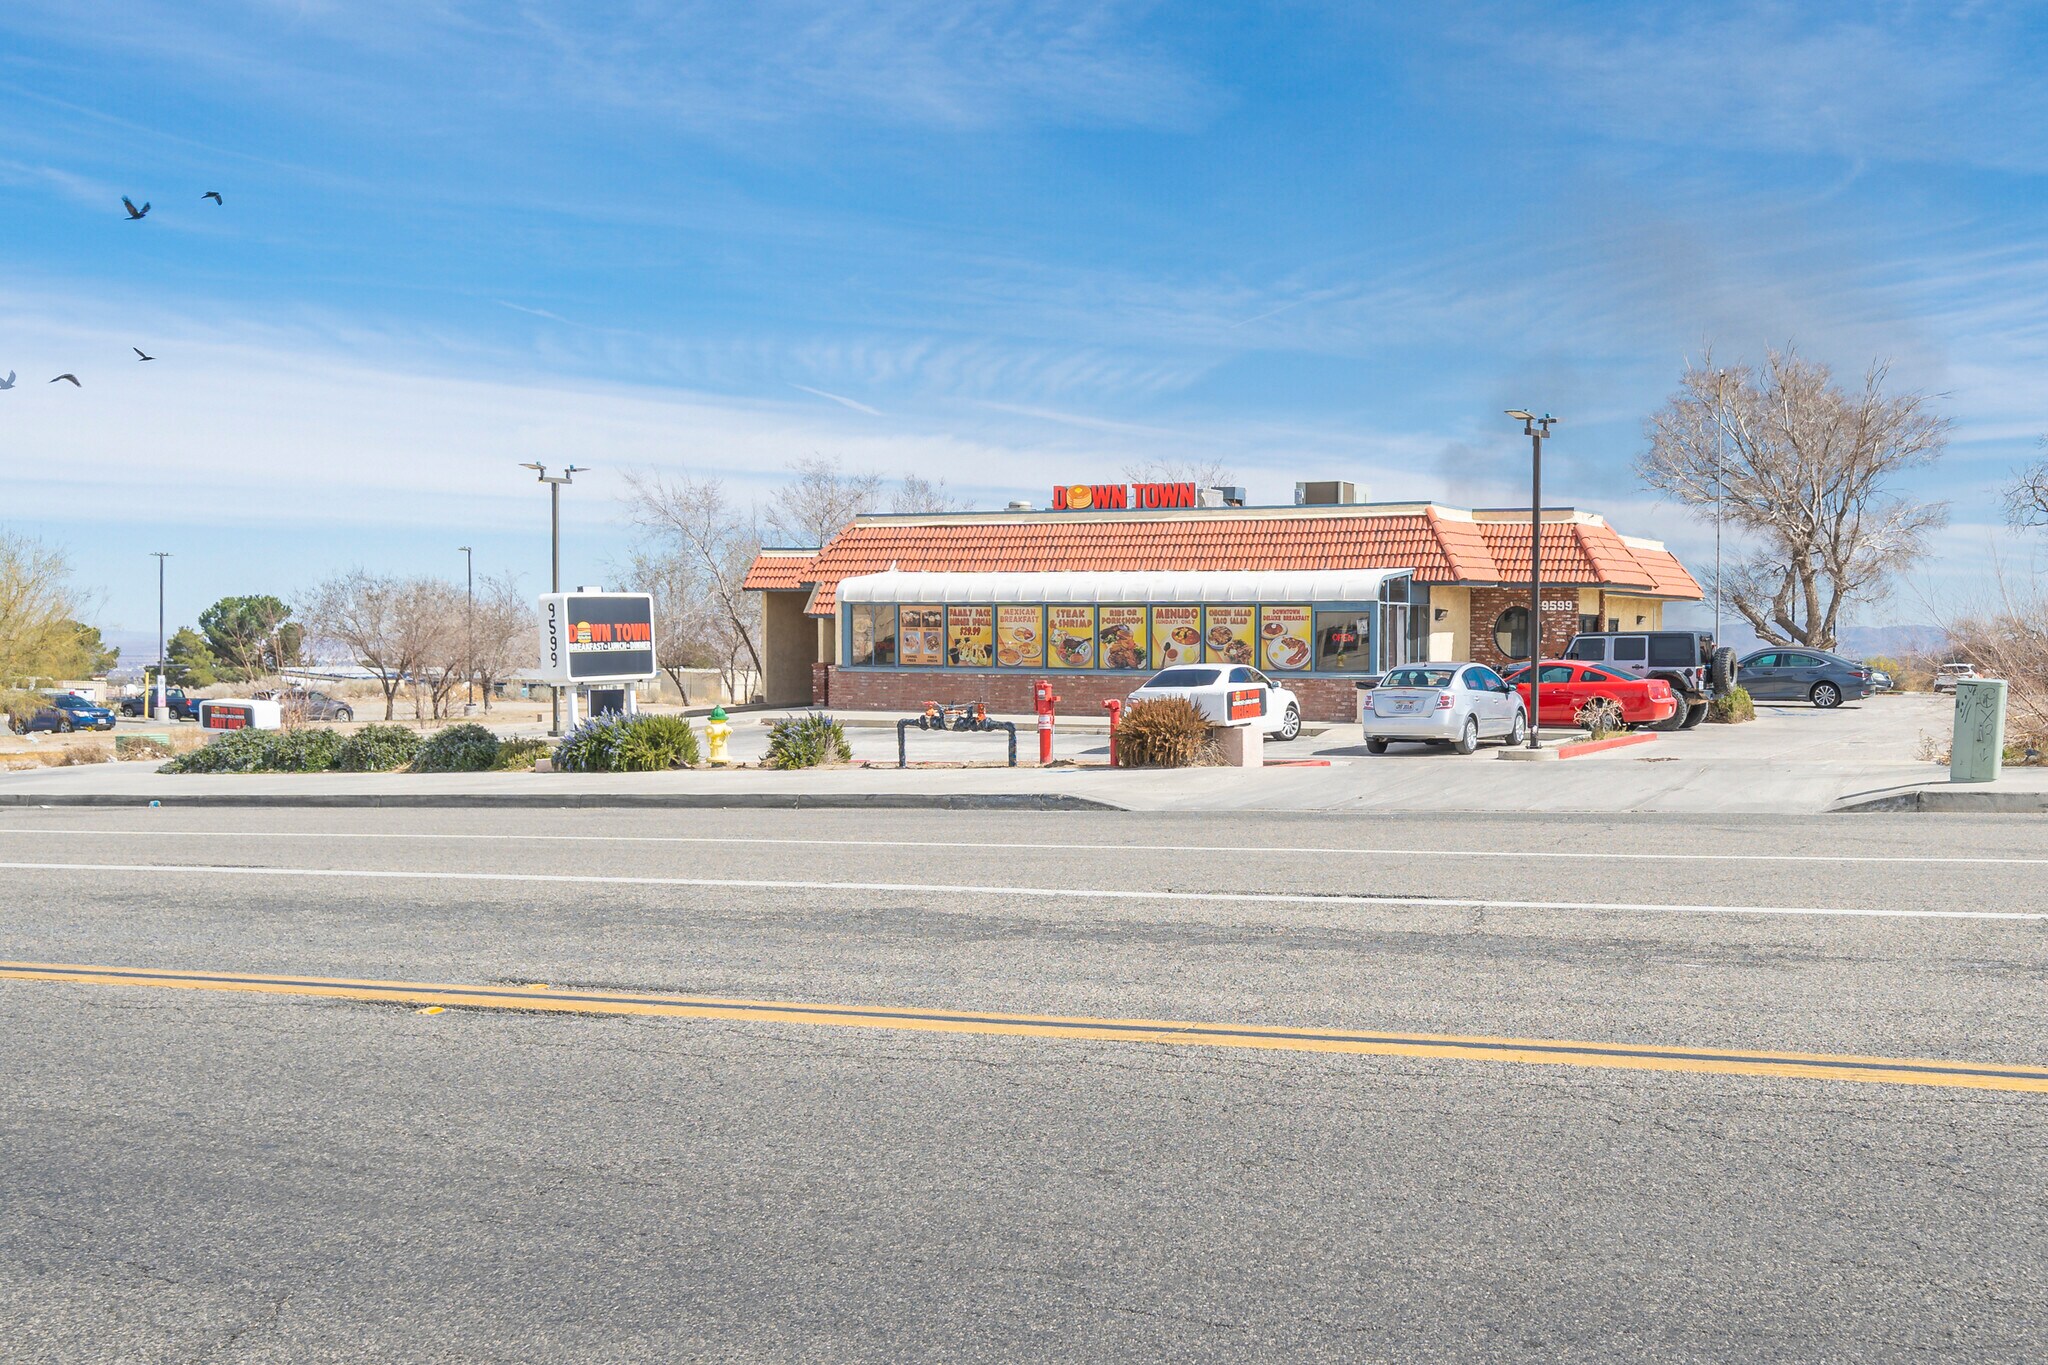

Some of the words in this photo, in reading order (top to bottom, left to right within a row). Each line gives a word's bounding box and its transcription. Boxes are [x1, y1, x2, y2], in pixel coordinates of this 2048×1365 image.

[1132, 482, 1195, 508] TOWN
[1541, 600, 1573, 611] 9599
[975, 608, 991, 617] PACK
[1004, 608, 1036, 616] MEXICAN
[1056, 608, 1085, 618] STEAK
[1109, 609, 1125, 617] RIBS
[1126, 608, 1137, 616] OR
[1155, 608, 1199, 619] MENUDO
[1234, 609, 1252, 617] SALAD
[1000, 615, 1039, 623] BREAKFAST
[1058, 618, 1093, 628] SHRIMP
[1213, 617, 1227, 625] TACO
[1229, 617, 1248, 625] SALAD
[548, 603, 557, 668] 9599
[614, 623, 651, 641] TOWN
[960, 626, 981, 636] $29.99
[1331, 633, 1354, 642] OPEN
